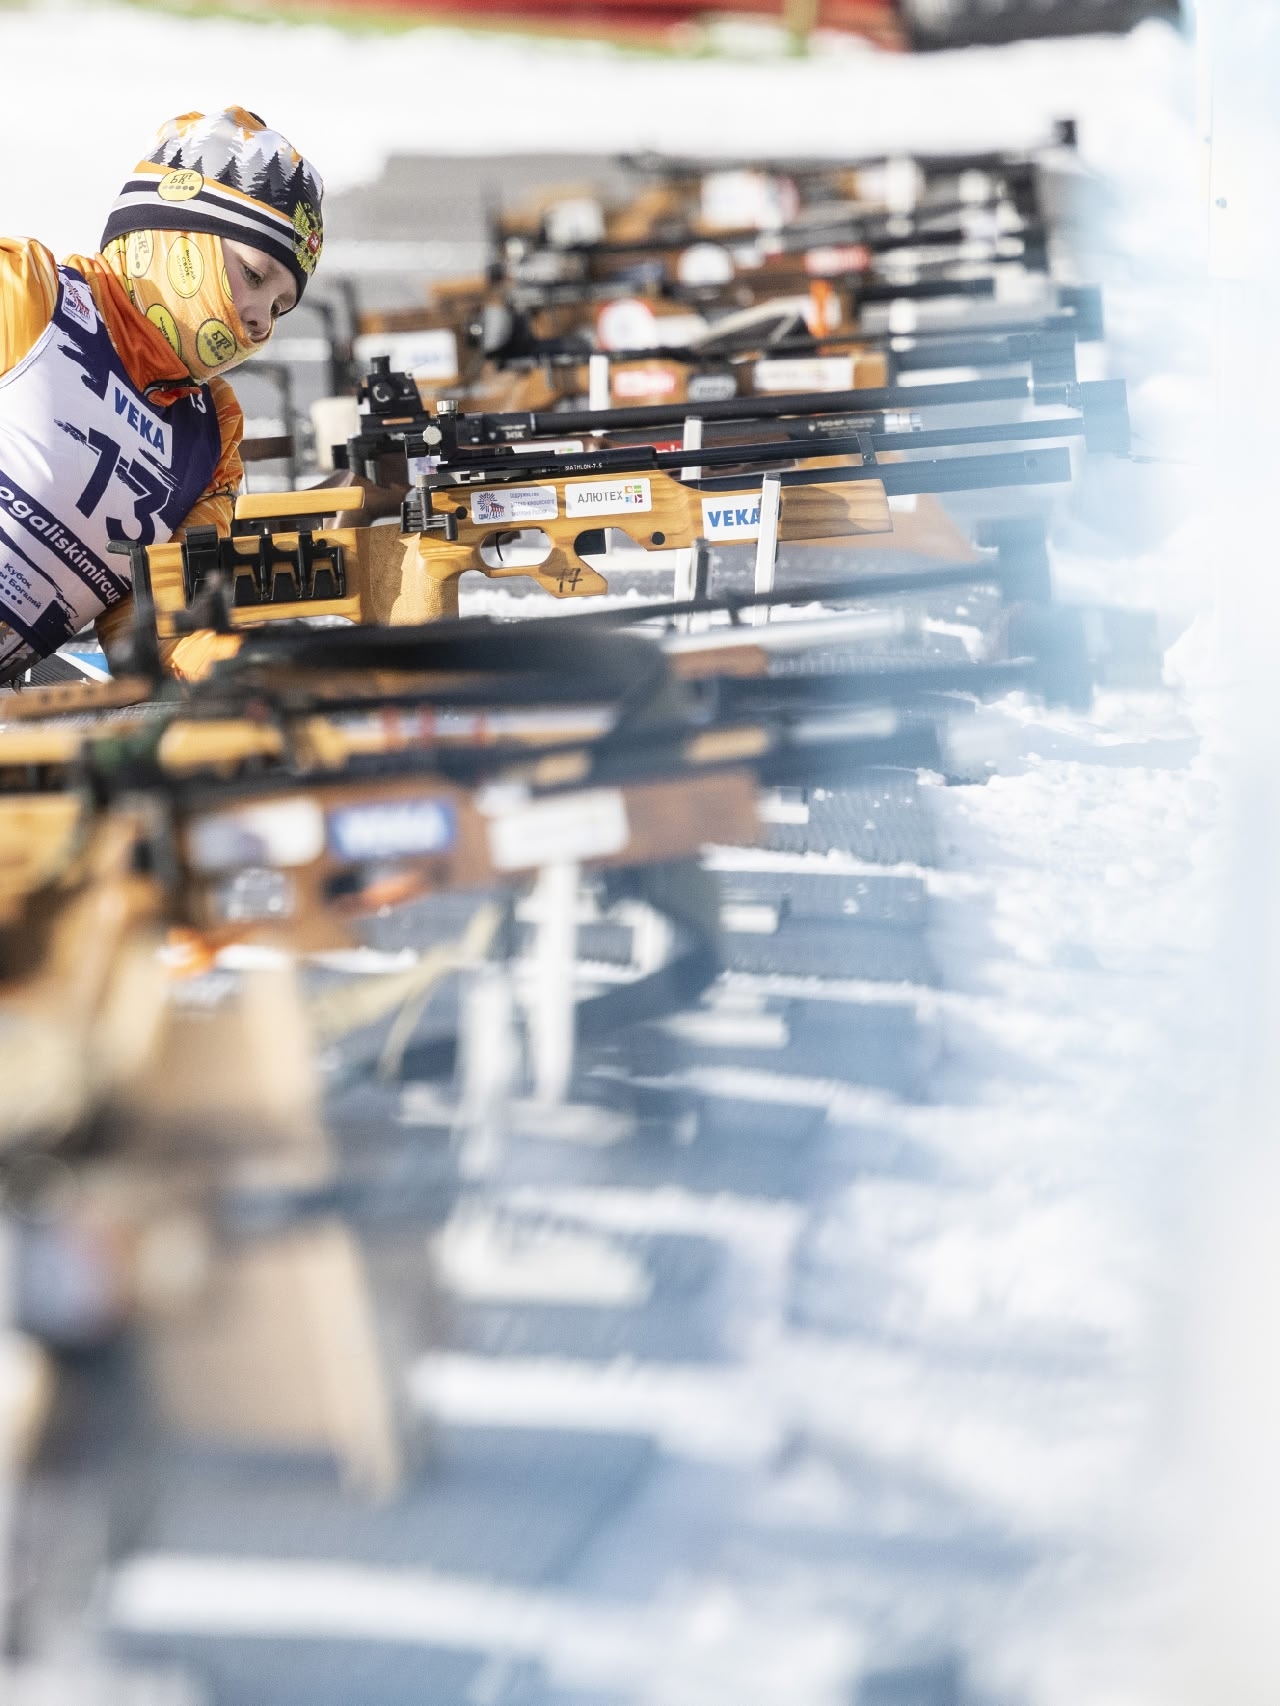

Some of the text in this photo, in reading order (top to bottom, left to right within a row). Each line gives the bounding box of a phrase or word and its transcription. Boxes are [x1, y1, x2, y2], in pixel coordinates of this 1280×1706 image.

[114, 387, 165, 455] VEKA
[577, 491, 623, 504] АЛЮТЕХ
[707, 507, 761, 528] VEKA
[4, 562, 32, 590] Кубок
